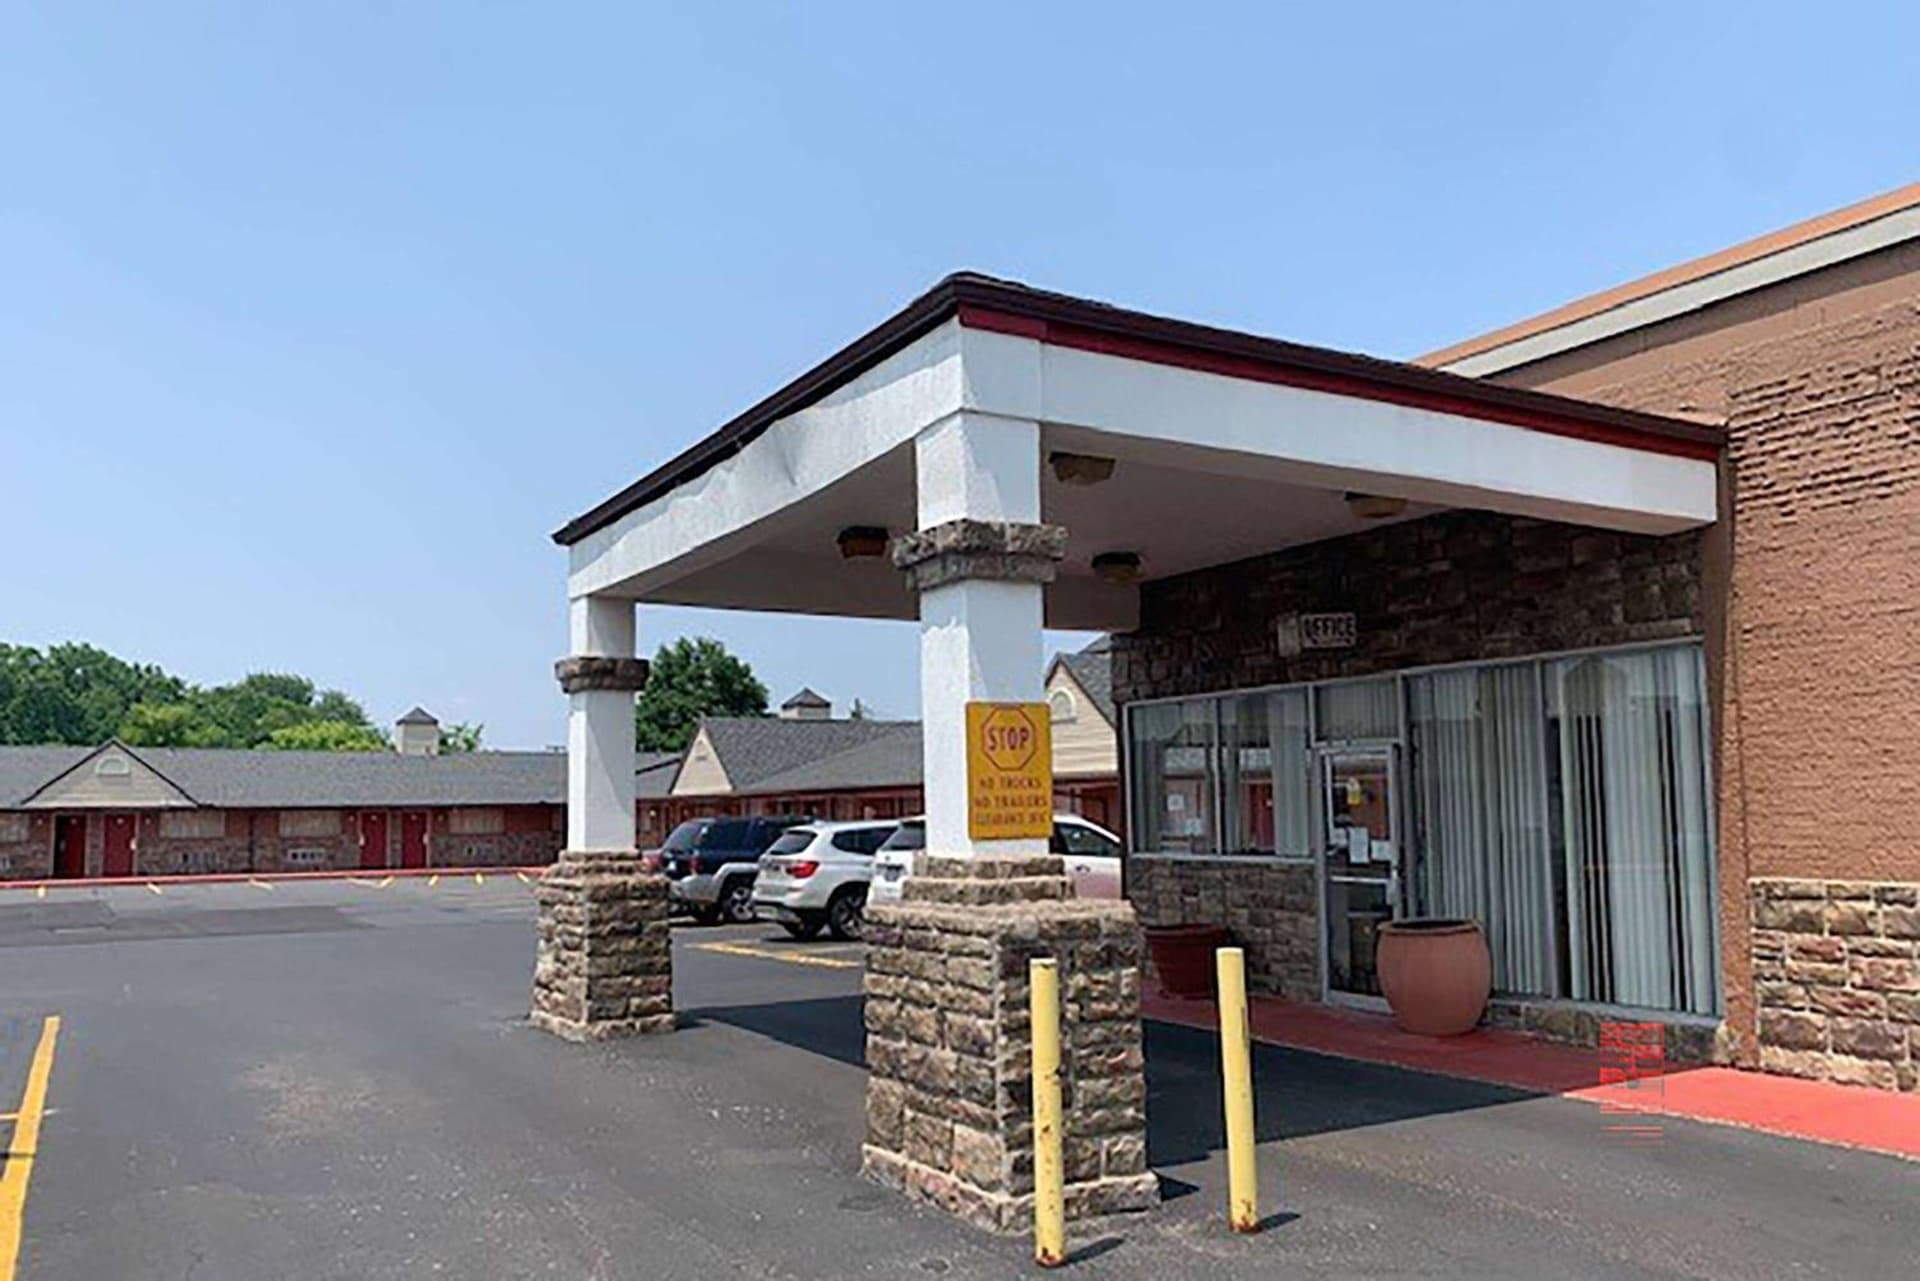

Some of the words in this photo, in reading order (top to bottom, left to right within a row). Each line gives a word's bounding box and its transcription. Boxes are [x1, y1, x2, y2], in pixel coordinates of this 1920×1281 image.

[1303, 616, 1355, 639] OFFICE
[986, 726, 1030, 751] STOP
[979, 777, 995, 790] NO
[974, 795, 991, 808] NO
